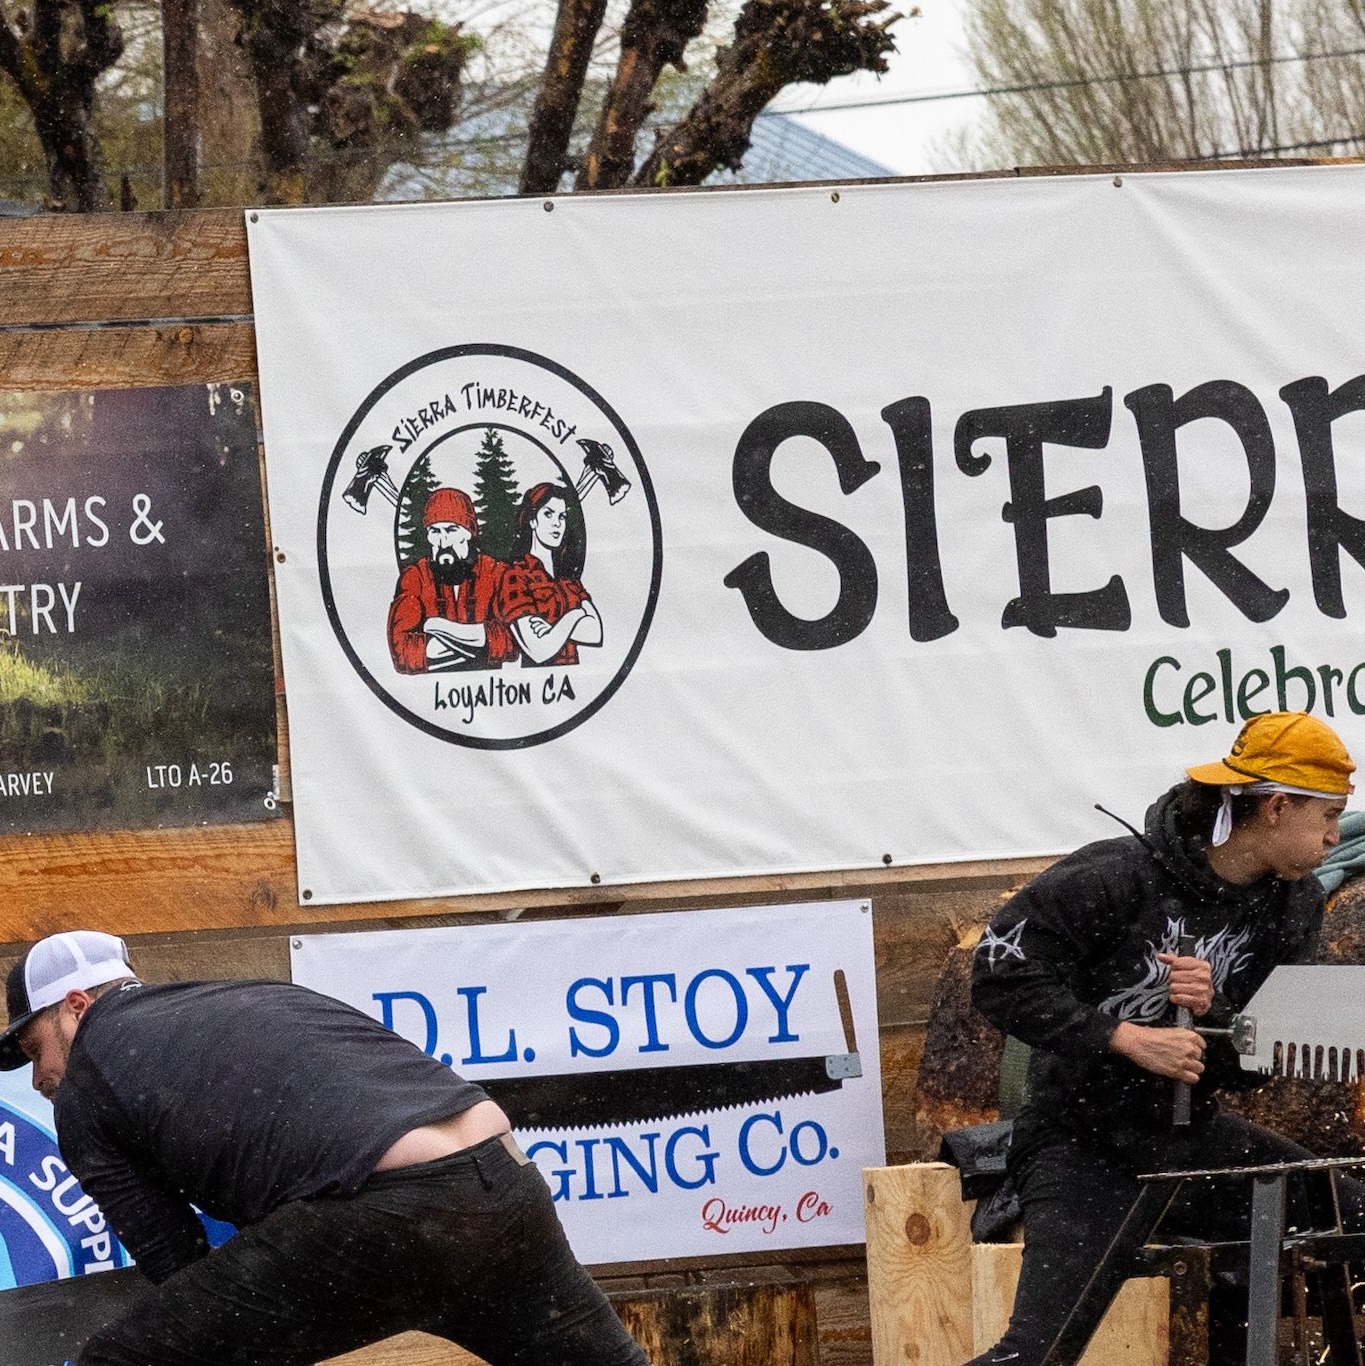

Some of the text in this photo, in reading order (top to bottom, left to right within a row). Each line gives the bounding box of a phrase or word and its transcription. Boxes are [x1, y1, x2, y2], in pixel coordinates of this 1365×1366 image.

[129, 493, 166, 546] &
[541, 673, 576, 705] CA
[146, 765, 182, 788] LTO
[189, 762, 233, 786] A-26
[372, 964, 810, 1066] D.L. STOY
[737, 1111, 840, 1177] Co.
[701, 1191, 833, 1234] Quincy, Ca
